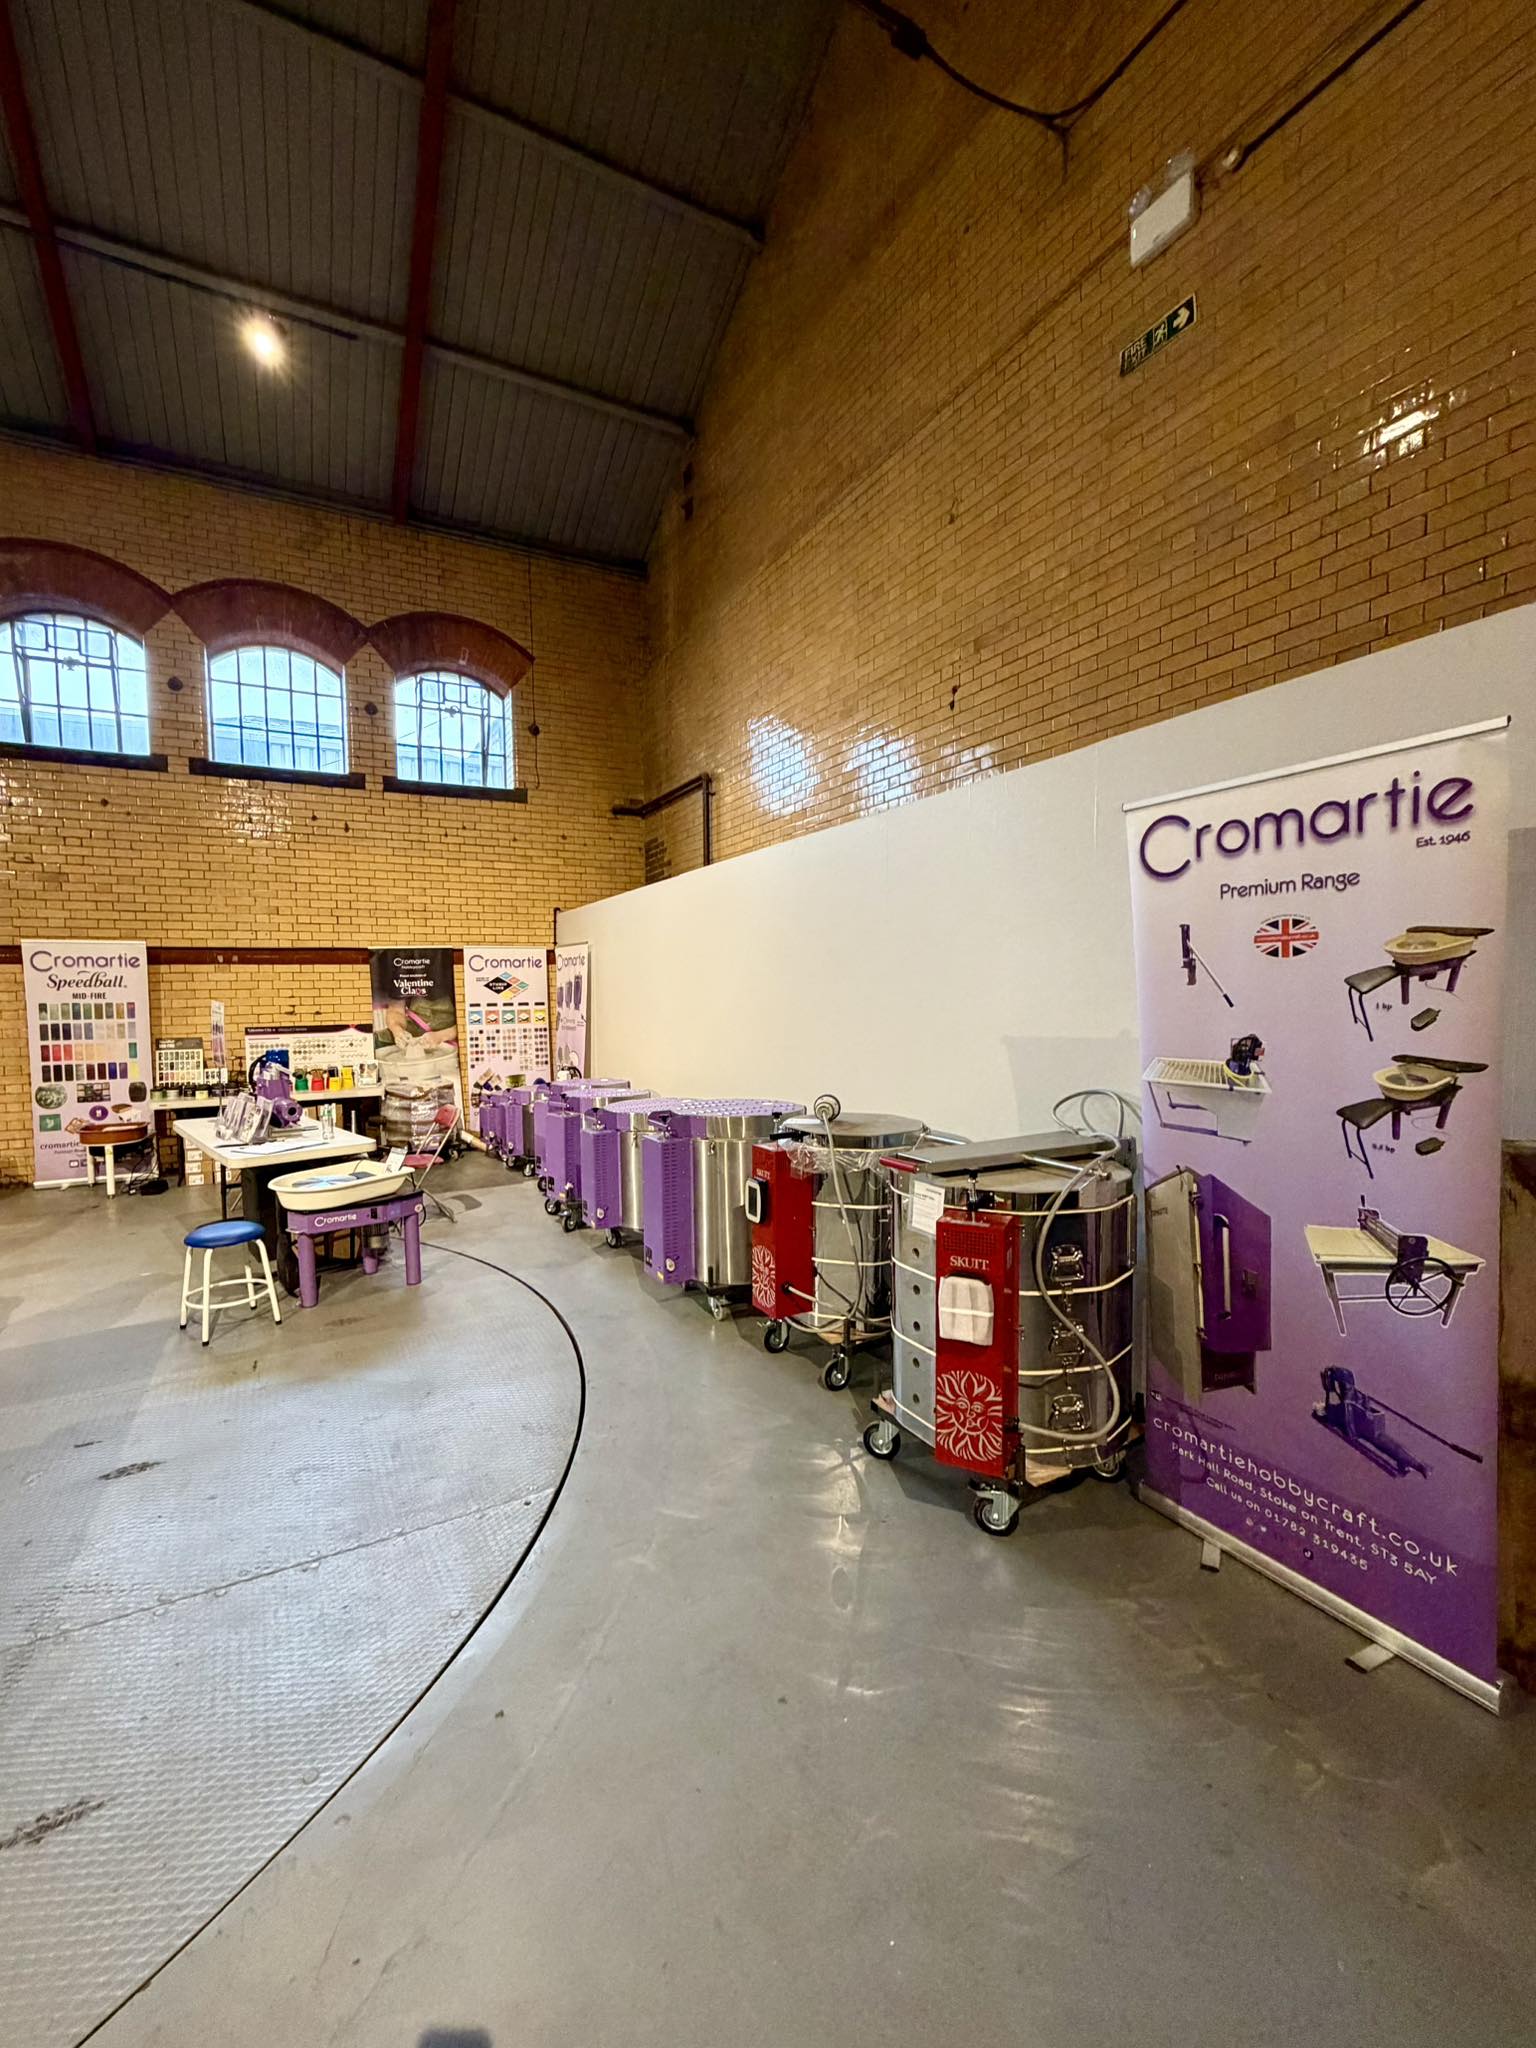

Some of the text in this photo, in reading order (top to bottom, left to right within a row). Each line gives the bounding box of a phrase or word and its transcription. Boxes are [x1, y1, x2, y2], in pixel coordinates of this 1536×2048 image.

[1139, 769, 1474, 879] Cromartie
[1440, 830, 1471, 845] 1946
[1220, 870, 1360, 900] Premium Range
[30, 950, 140, 972] Cromartie
[393, 957, 431, 967] Cromartie
[468, 954, 543, 972] Cromartie
[393, 978, 434, 988] Valentine
[314, 1213, 357, 1228] Cromartie
[949, 1255, 990, 1271] SKUTT
[1153, 1417, 1459, 1577] cromartiehobbycraft.co.uk
[1206, 1476, 1228, 1496] Call
[1231, 1490, 1243, 1504] us
[1246, 1499, 1261, 1513] on
[1264, 1508, 1306, 1537] 01782
[1172, 1442, 1195, 1461] Park
[1198, 1456, 1220, 1474] Hall
[1223, 1468, 1257, 1494] Road,
[1260, 1487, 1297, 1514] Stoke
[1301, 1510, 1318, 1525] on
[1371, 1543, 1399, 1567] ST3
[1403, 1561, 1437, 1585] 5AY
